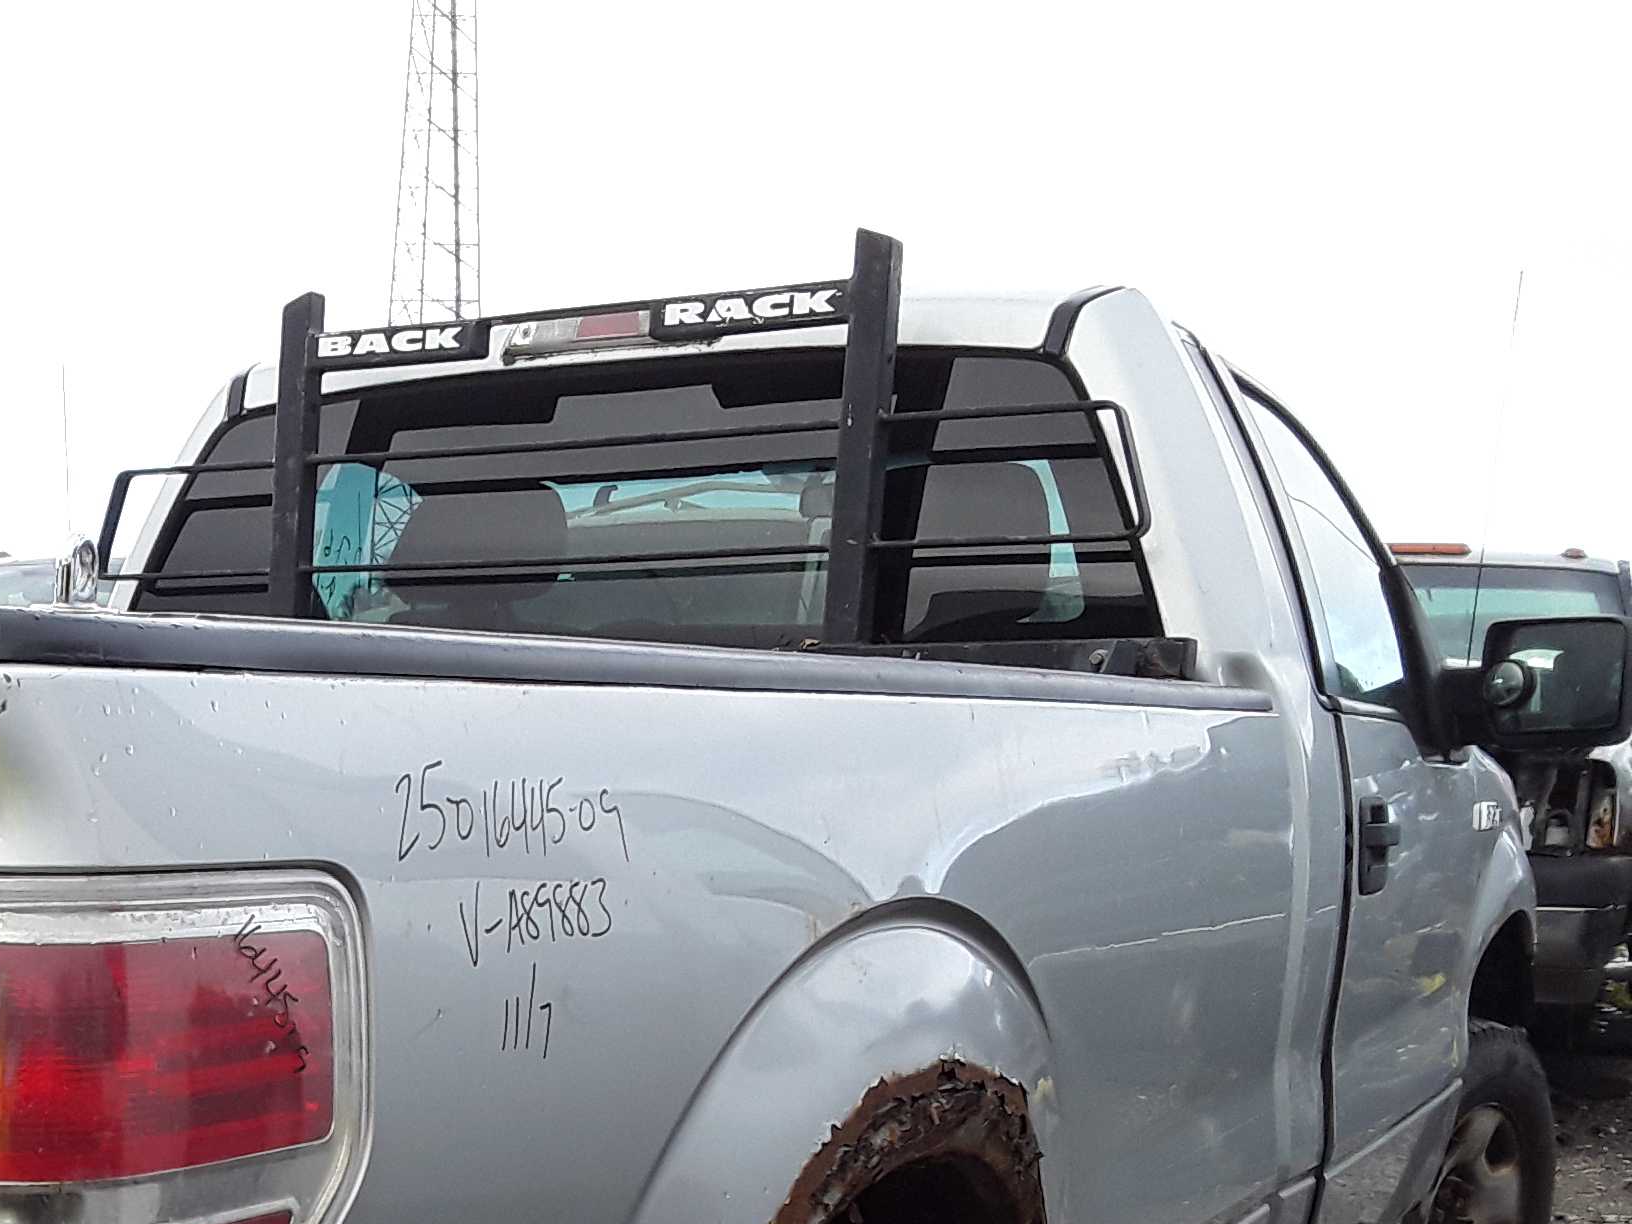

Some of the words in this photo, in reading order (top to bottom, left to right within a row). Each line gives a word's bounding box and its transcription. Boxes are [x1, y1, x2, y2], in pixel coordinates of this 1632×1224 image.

[318, 327, 463, 357] BACK
[664, 289, 840, 326] RACK
[501, 962, 553, 1059] 11/7
